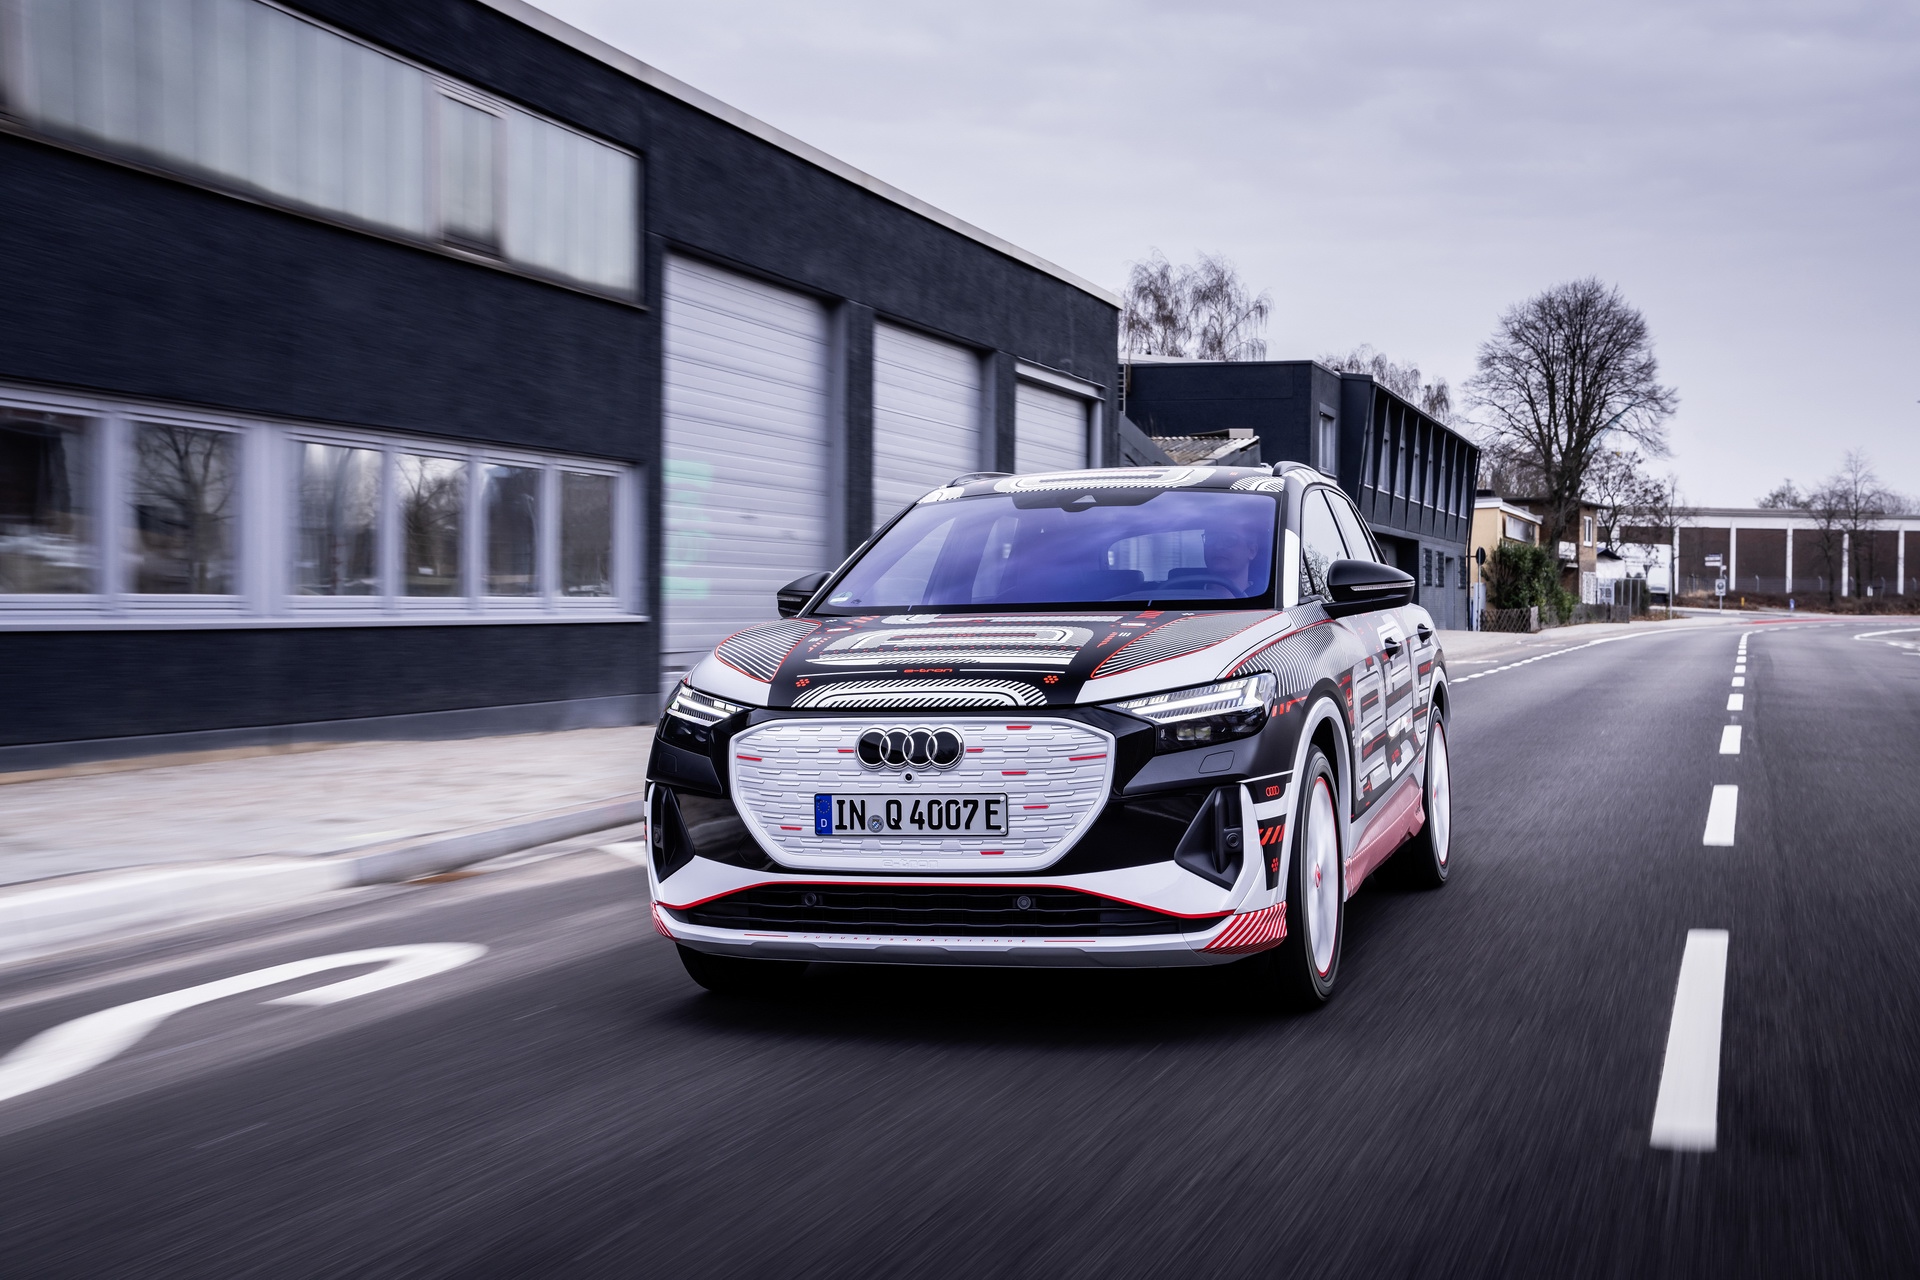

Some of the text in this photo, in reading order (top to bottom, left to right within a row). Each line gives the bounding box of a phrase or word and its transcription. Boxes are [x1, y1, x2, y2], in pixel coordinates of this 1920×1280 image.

[835, 799, 866, 830] IN
[886, 799, 902, 830] Q
[820, 818, 828, 828] D
[882, 858, 938, 868] e-tron
